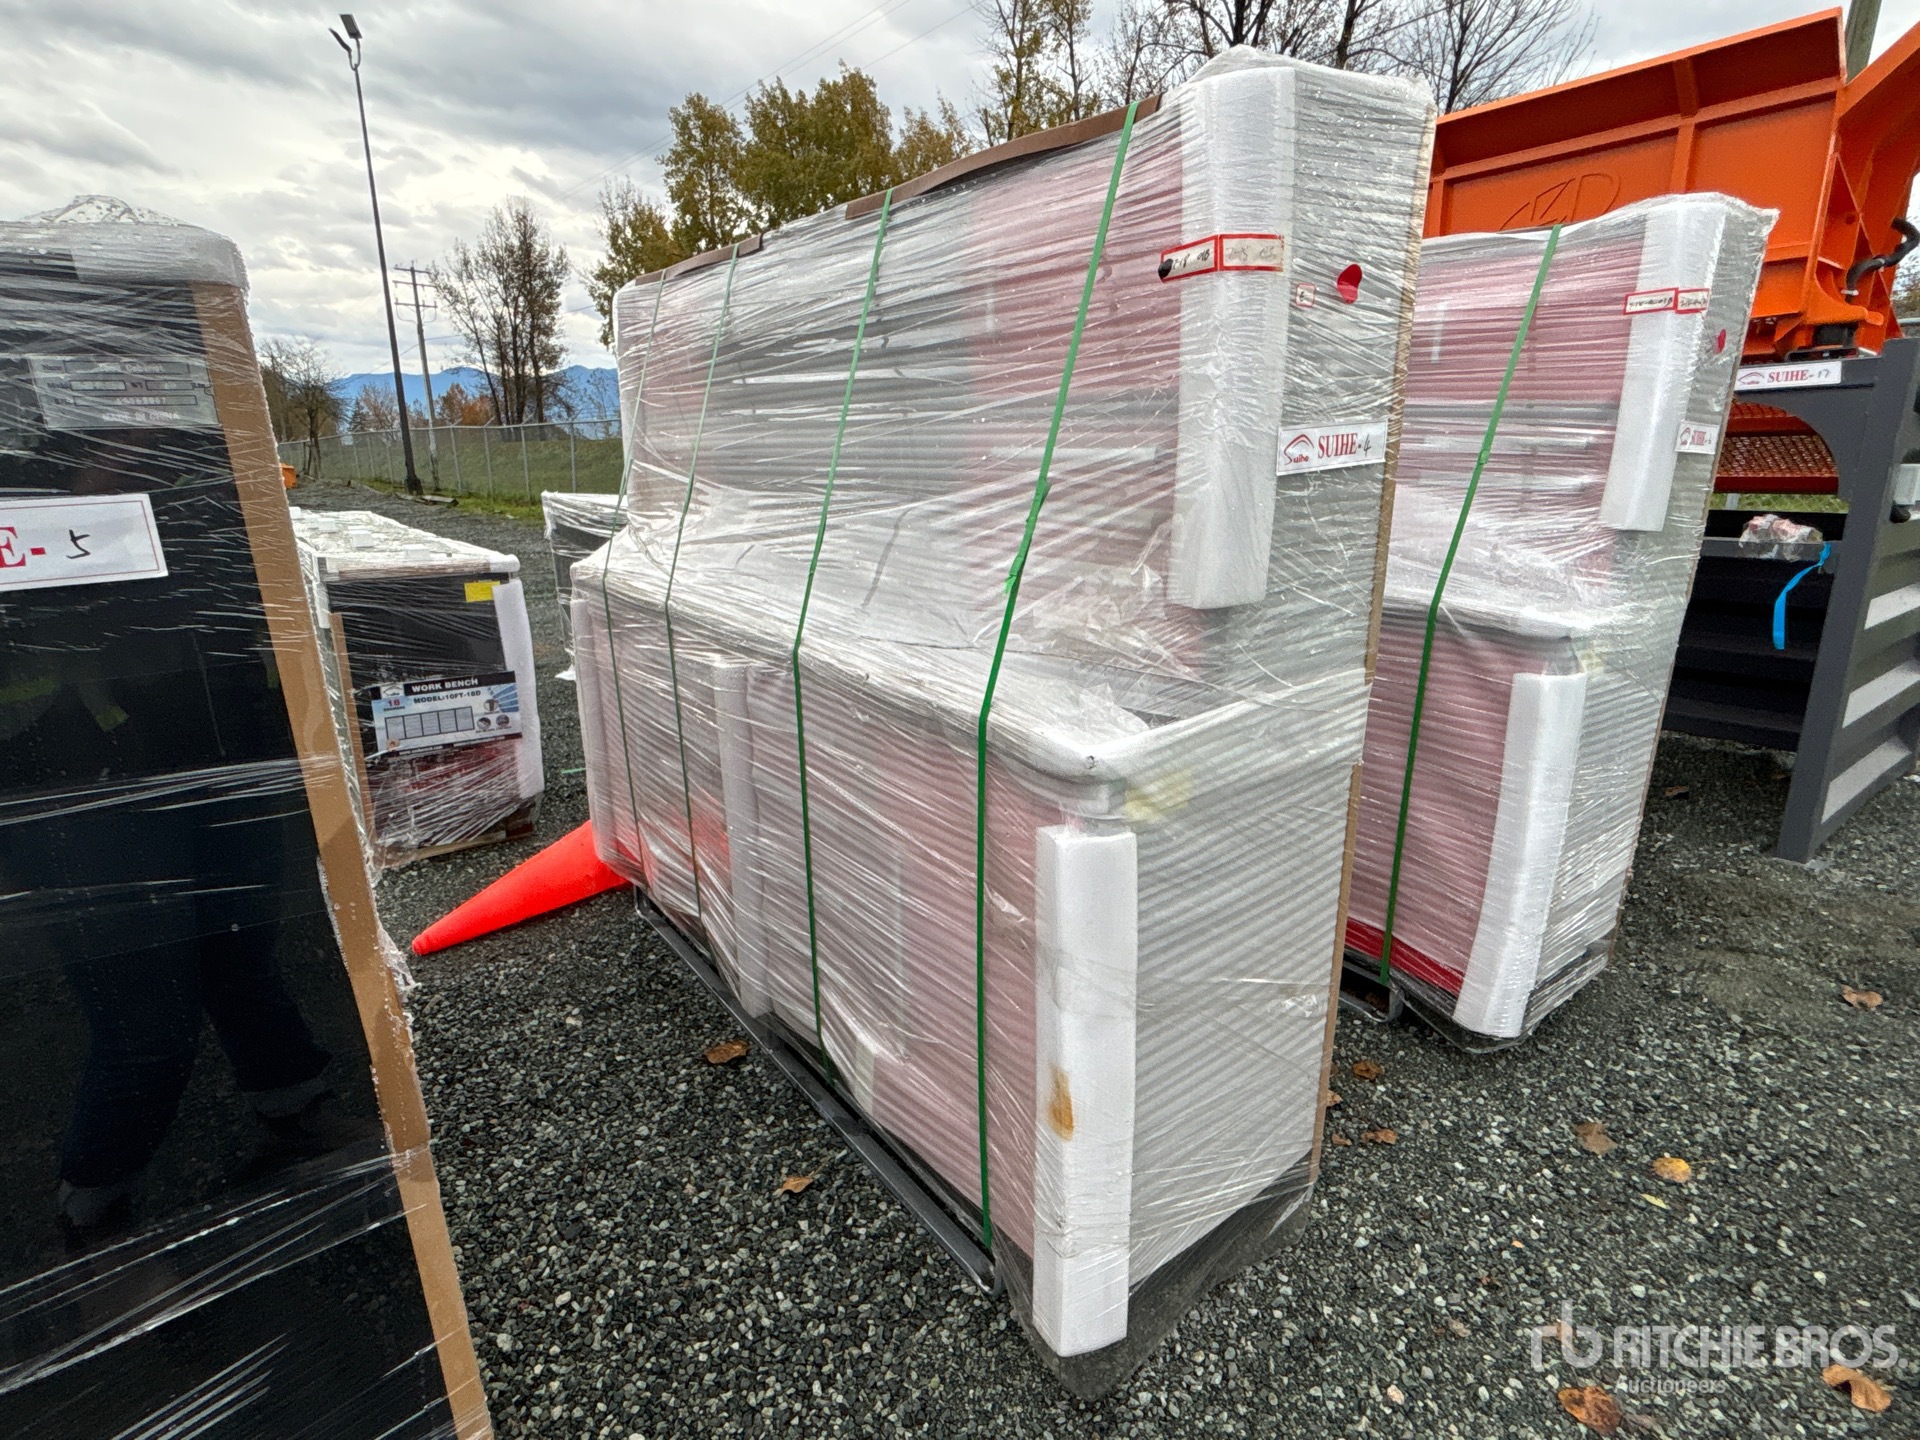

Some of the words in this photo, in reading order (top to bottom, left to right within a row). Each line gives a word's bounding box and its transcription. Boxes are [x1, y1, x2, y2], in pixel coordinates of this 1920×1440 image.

[411, 683, 443, 694] WORK
[444, 677, 479, 690] BENCH
[387, 698, 401, 708] 18
